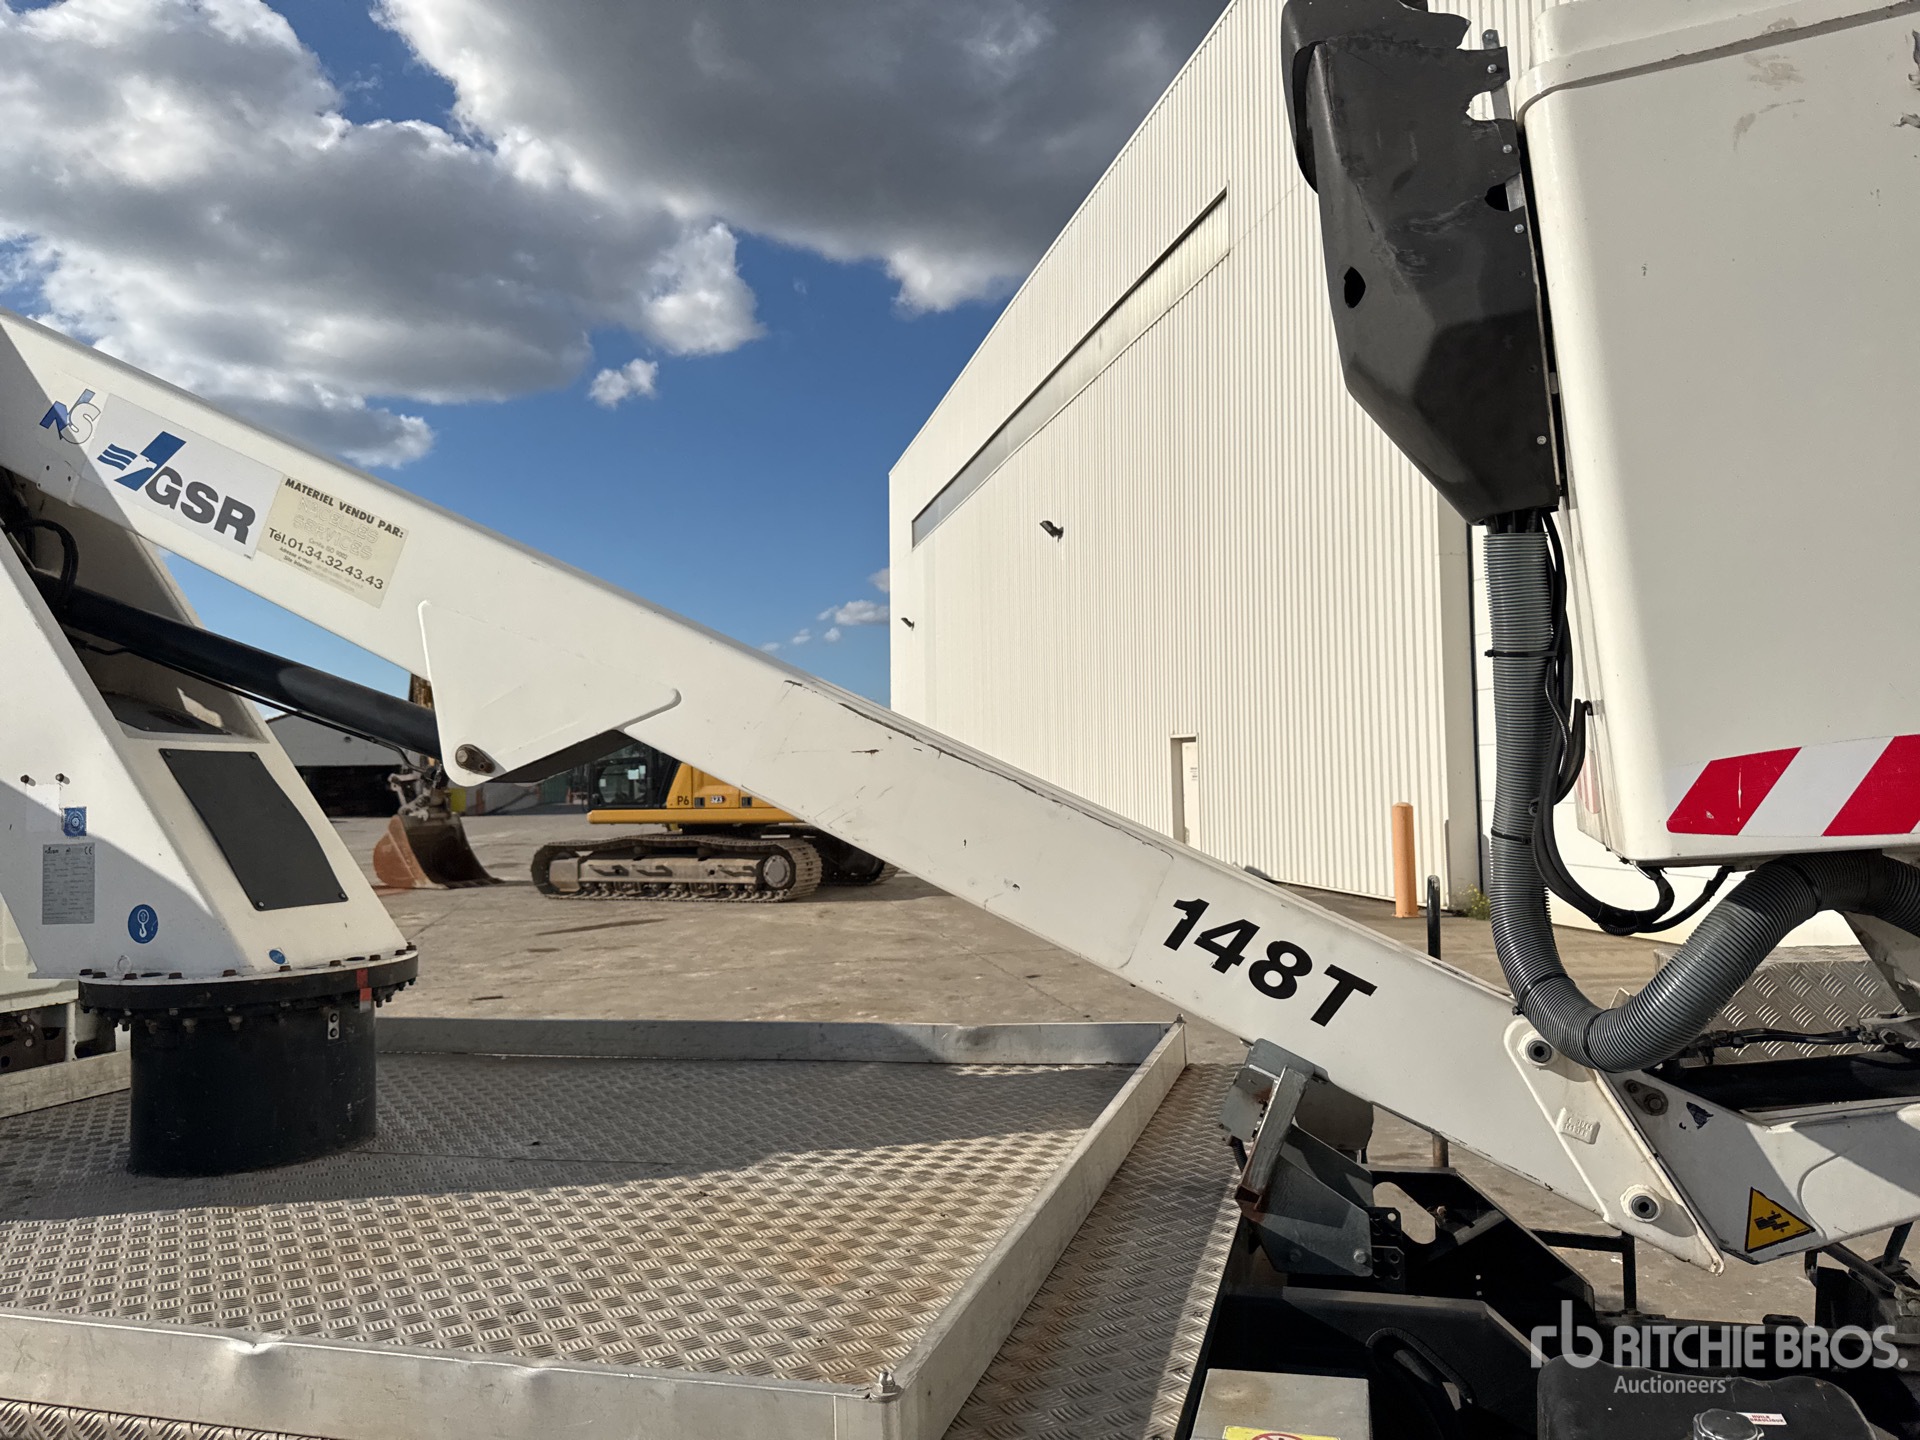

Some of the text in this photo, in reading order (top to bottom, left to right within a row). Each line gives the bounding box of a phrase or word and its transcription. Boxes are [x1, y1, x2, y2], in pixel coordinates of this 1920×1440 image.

[145, 466, 256, 545] GSR
[284, 478, 404, 539] MATERIEL VENDU PAR:
[268, 527, 384, 590] Tél.01.34.32.43.43
[677, 796, 689, 805] P6
[1163, 898, 1378, 1027] 148T
